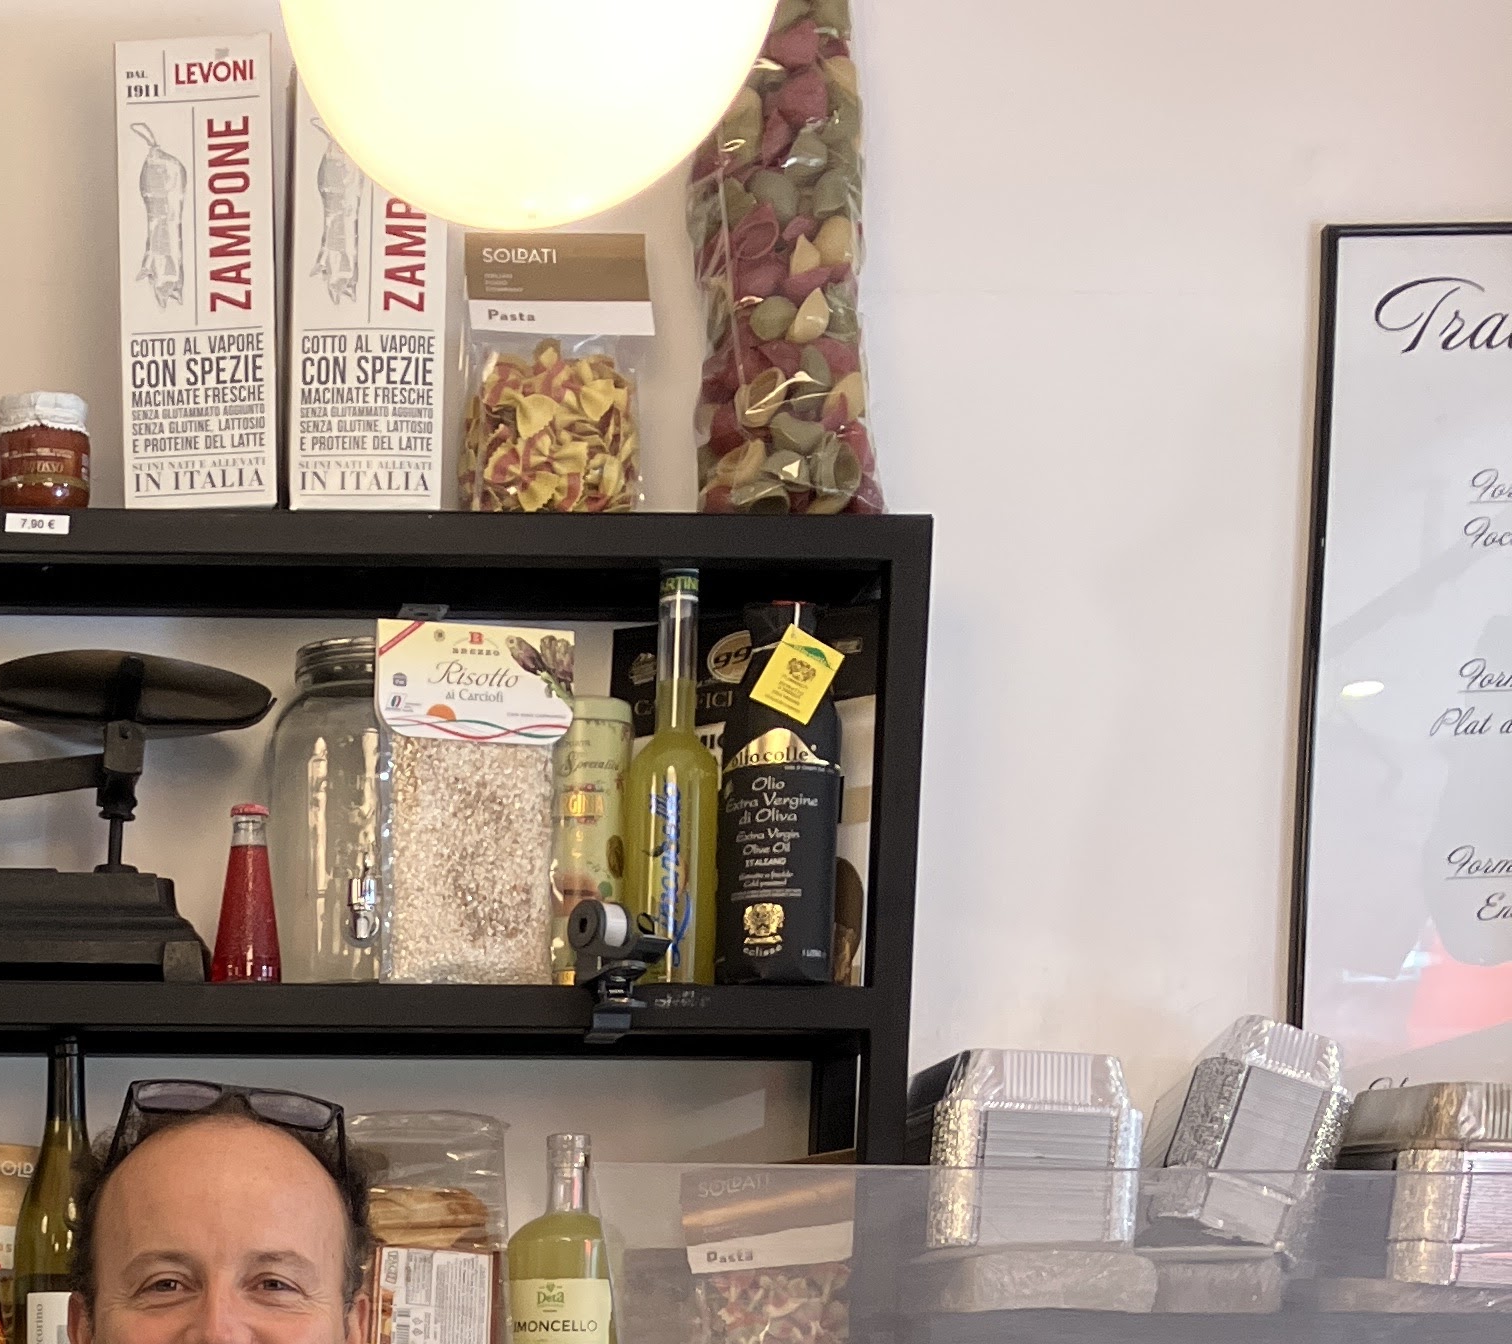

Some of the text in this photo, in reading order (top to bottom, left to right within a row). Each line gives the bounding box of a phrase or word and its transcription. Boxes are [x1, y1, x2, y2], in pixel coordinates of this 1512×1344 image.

[174, 59, 254, 85] LEVONI
[126, 84, 160, 98] 1911
[206, 115, 252, 313] ZAMPONE
[384, 197, 427, 313] ZAMP
[482, 248, 557, 264] SOLDATI
[487, 308, 536, 322] Pasta
[1374, 276, 1512, 354] Tra
[131, 332, 264, 358] COTTO AL VAPORE
[302, 334, 436, 354] COTTO AL VAPORE
[132, 354, 264, 389] CON SPEZIE
[302, 356, 434, 387] CON SPEZIE
[132, 385, 264, 408] MACINATE FRESCHE
[132, 422, 165, 436] SENZA
[218, 416, 265, 431] LATTOSIO
[133, 432, 266, 454] E PROTEINE DEL LATTE
[135, 467, 265, 492] IN ITALIA
[46, 519, 56, 529] €
[428, 659, 520, 688] Risotto
[458, 690, 504, 703] Carciofi
[1429, 706, 1494, 737] Plat
[752, 776, 786, 791] Olio
[763, 791, 819, 810] Vergine
[739, 807, 798, 825] di Oliva
[706, 1248, 755, 1264] Pasta
[513, 1319, 599, 1334] IMONCELLO
